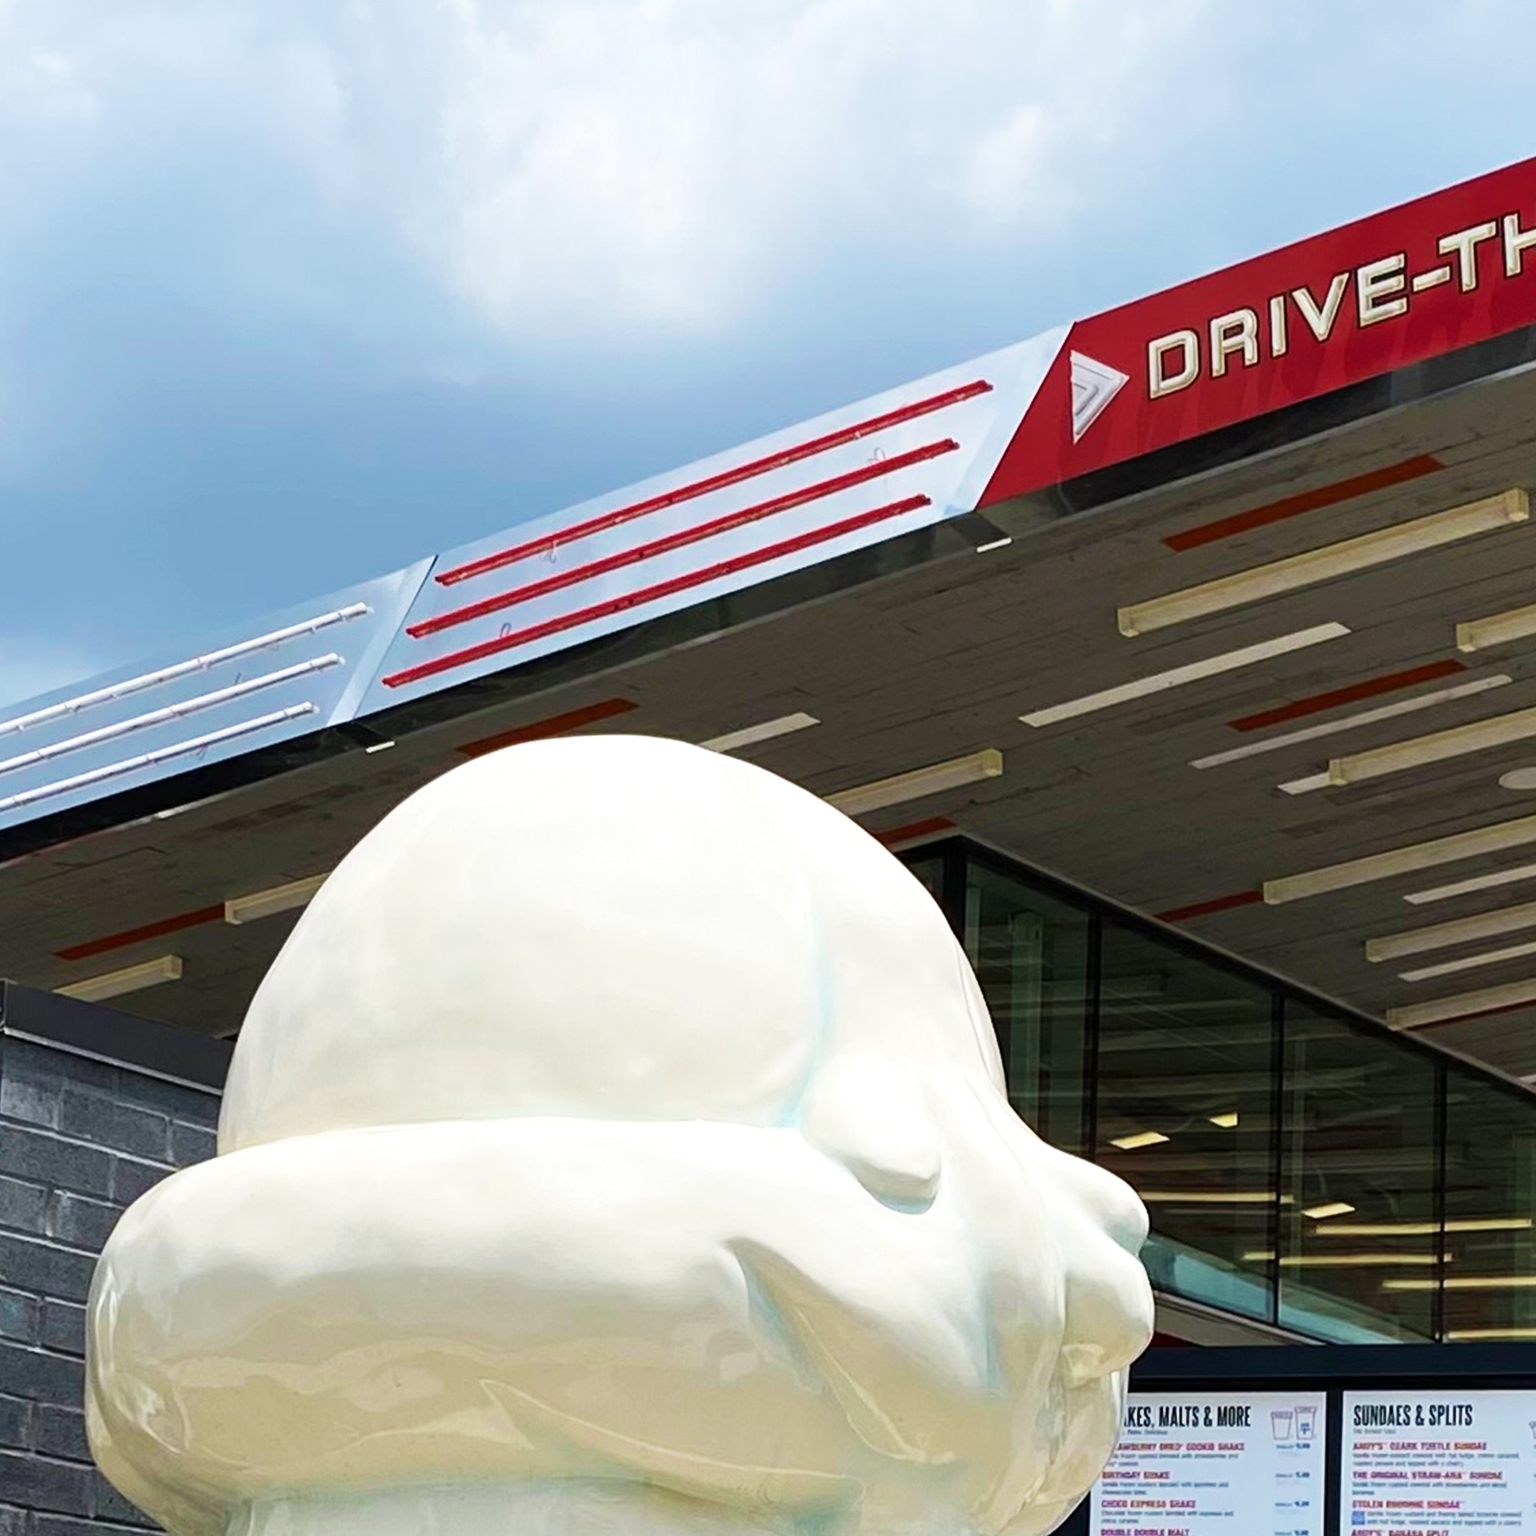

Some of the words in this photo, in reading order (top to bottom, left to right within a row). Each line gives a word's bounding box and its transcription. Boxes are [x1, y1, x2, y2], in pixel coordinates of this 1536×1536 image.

[1124, 1406, 1155, 1429] KES,
[1159, 1406, 1199, 1427] MALTS
[1204, 1406, 1213, 1427] &
[1217, 1406, 1251, 1427] MORE
[1353, 1404, 1411, 1426] SUNDAES
[1415, 1405, 1425, 1426] &
[1429, 1404, 1473, 1426] SPLITS
[1218, 1443, 1245, 1451] SHAKE
[1454, 1442, 1487, 1450] SUNDAE
[1353, 1471, 1367, 1479] THE
